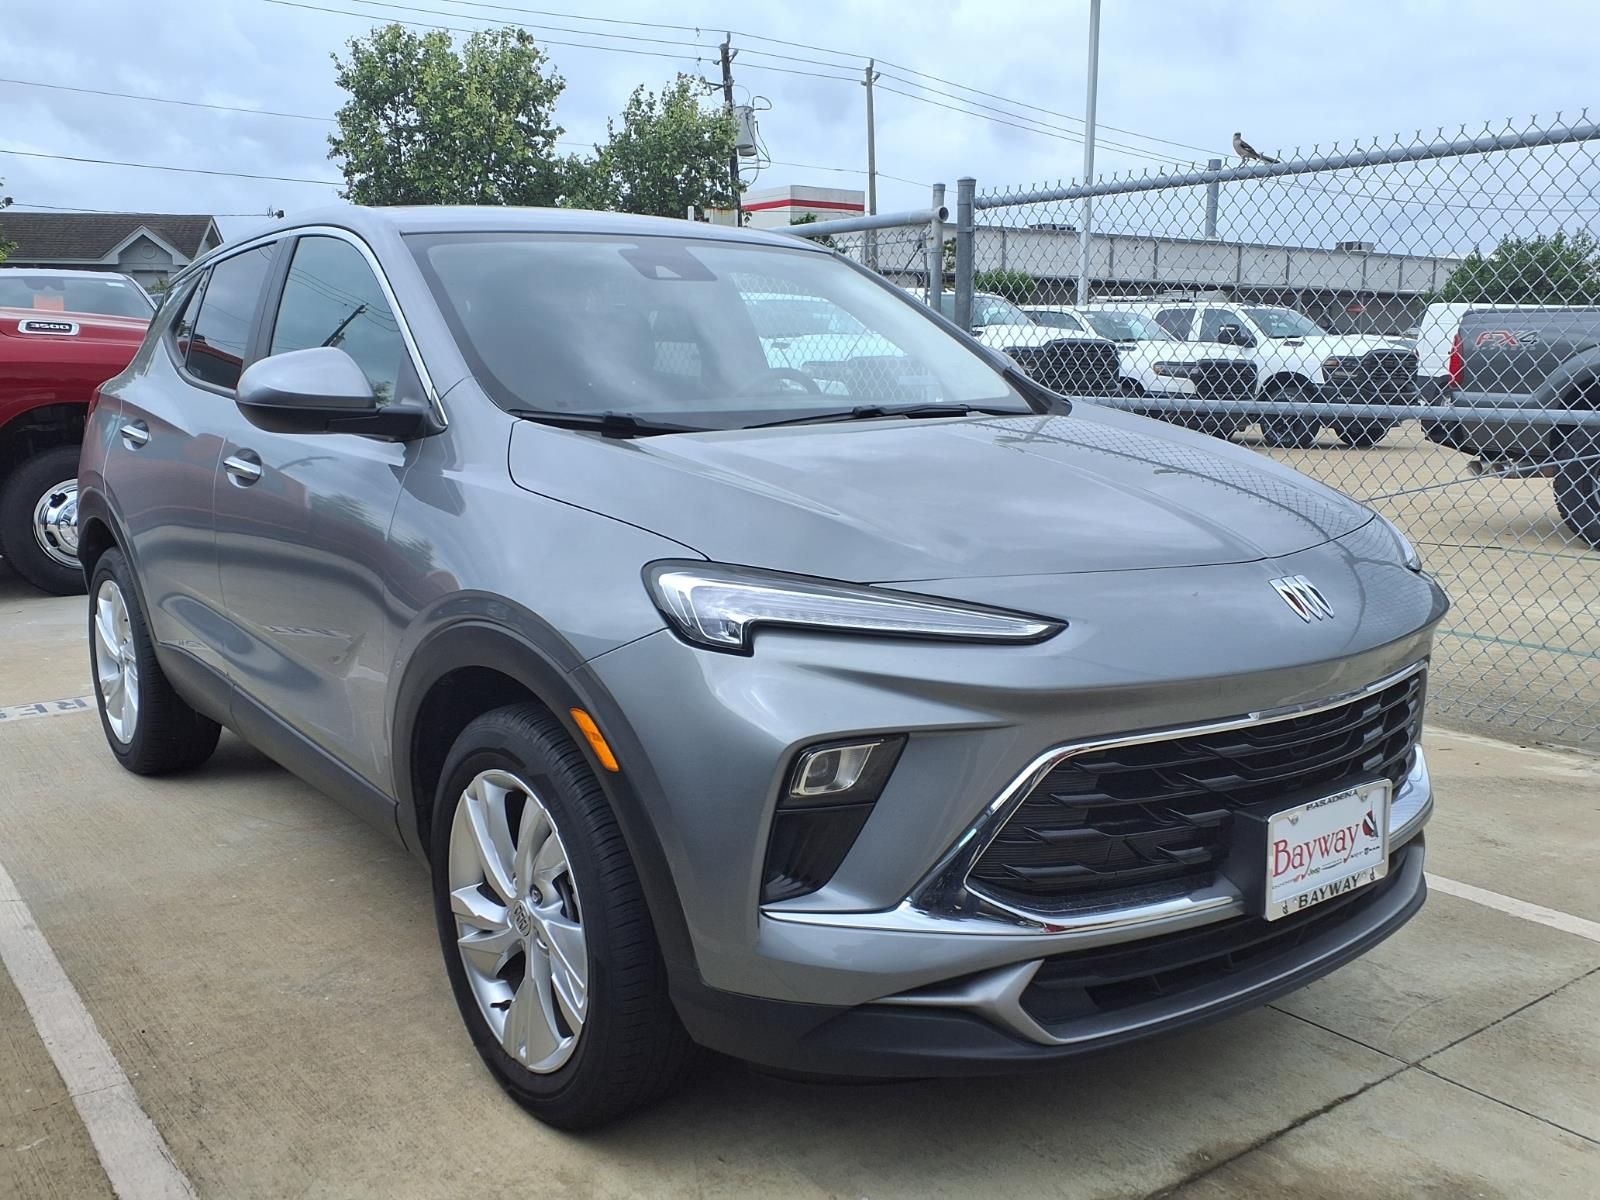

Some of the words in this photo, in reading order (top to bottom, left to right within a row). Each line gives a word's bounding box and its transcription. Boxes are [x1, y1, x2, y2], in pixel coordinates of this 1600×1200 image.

[30, 322, 70, 330] 3500
[1475, 330, 1540, 347] FX4
[0, 698, 88, 719] RE
[1306, 789, 1358, 811] PASADENA
[1272, 823, 1360, 880] Bayway
[1298, 873, 1361, 908] BAYWAY
